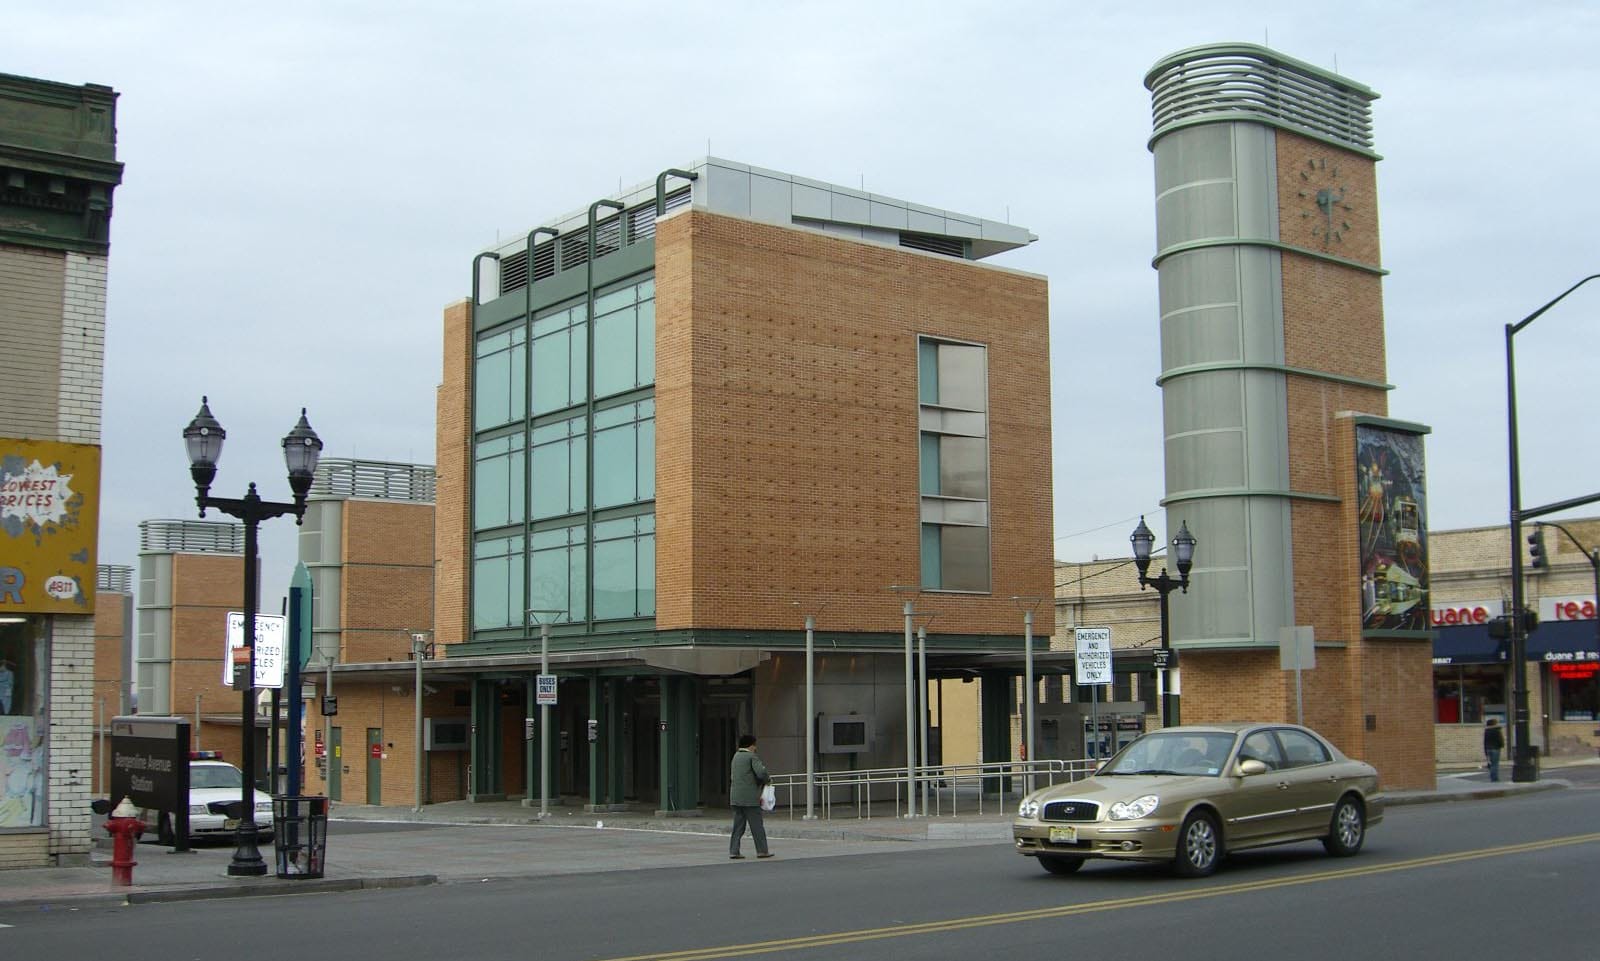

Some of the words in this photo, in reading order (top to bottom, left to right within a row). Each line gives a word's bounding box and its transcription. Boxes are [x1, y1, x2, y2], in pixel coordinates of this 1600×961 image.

[0, 480, 56, 491] LOWEST
[1431, 606, 1488, 625] uane
[1555, 600, 1596, 619] rea
[232, 619, 280, 631] EMGENCY
[1077, 632, 1108, 641] EMERGENCY
[1088, 642, 1099, 650] AND
[1078, 651, 1110, 660] AUTHORIZED
[1082, 661, 1107, 669] VEHICLES
[1086, 671, 1102, 679] ONLY
[148, 754, 172, 772] Avenue
[131, 774, 153, 793] Station
